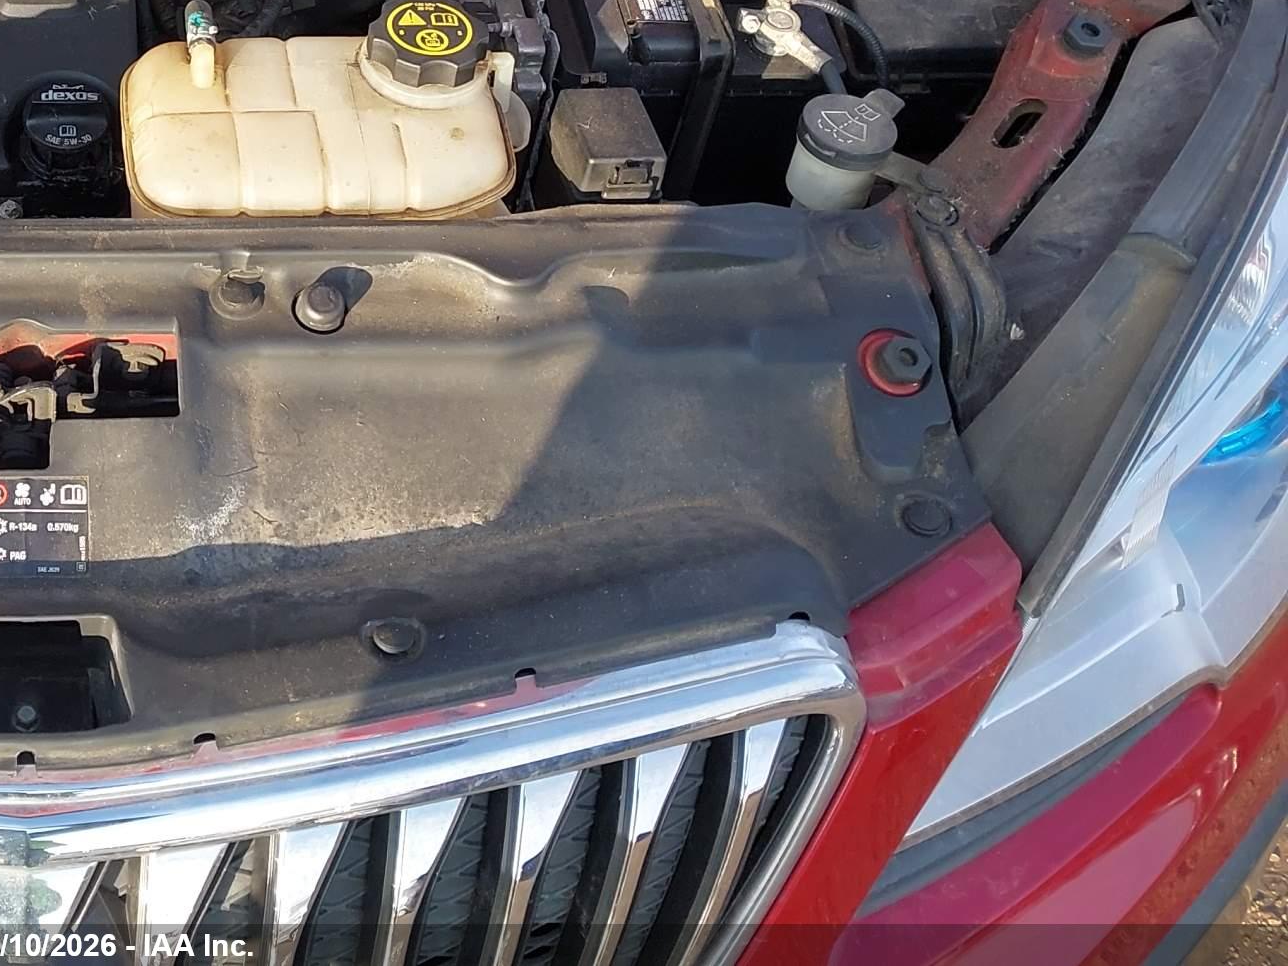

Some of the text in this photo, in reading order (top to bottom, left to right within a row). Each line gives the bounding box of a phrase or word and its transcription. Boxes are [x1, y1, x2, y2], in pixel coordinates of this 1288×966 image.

[40, 89, 99, 101] dexos
[45, 134, 92, 145] SAE 5W-30
[8, 522, 79, 533] R-134a 0.570kg
[9, 550, 26, 561] PAG
